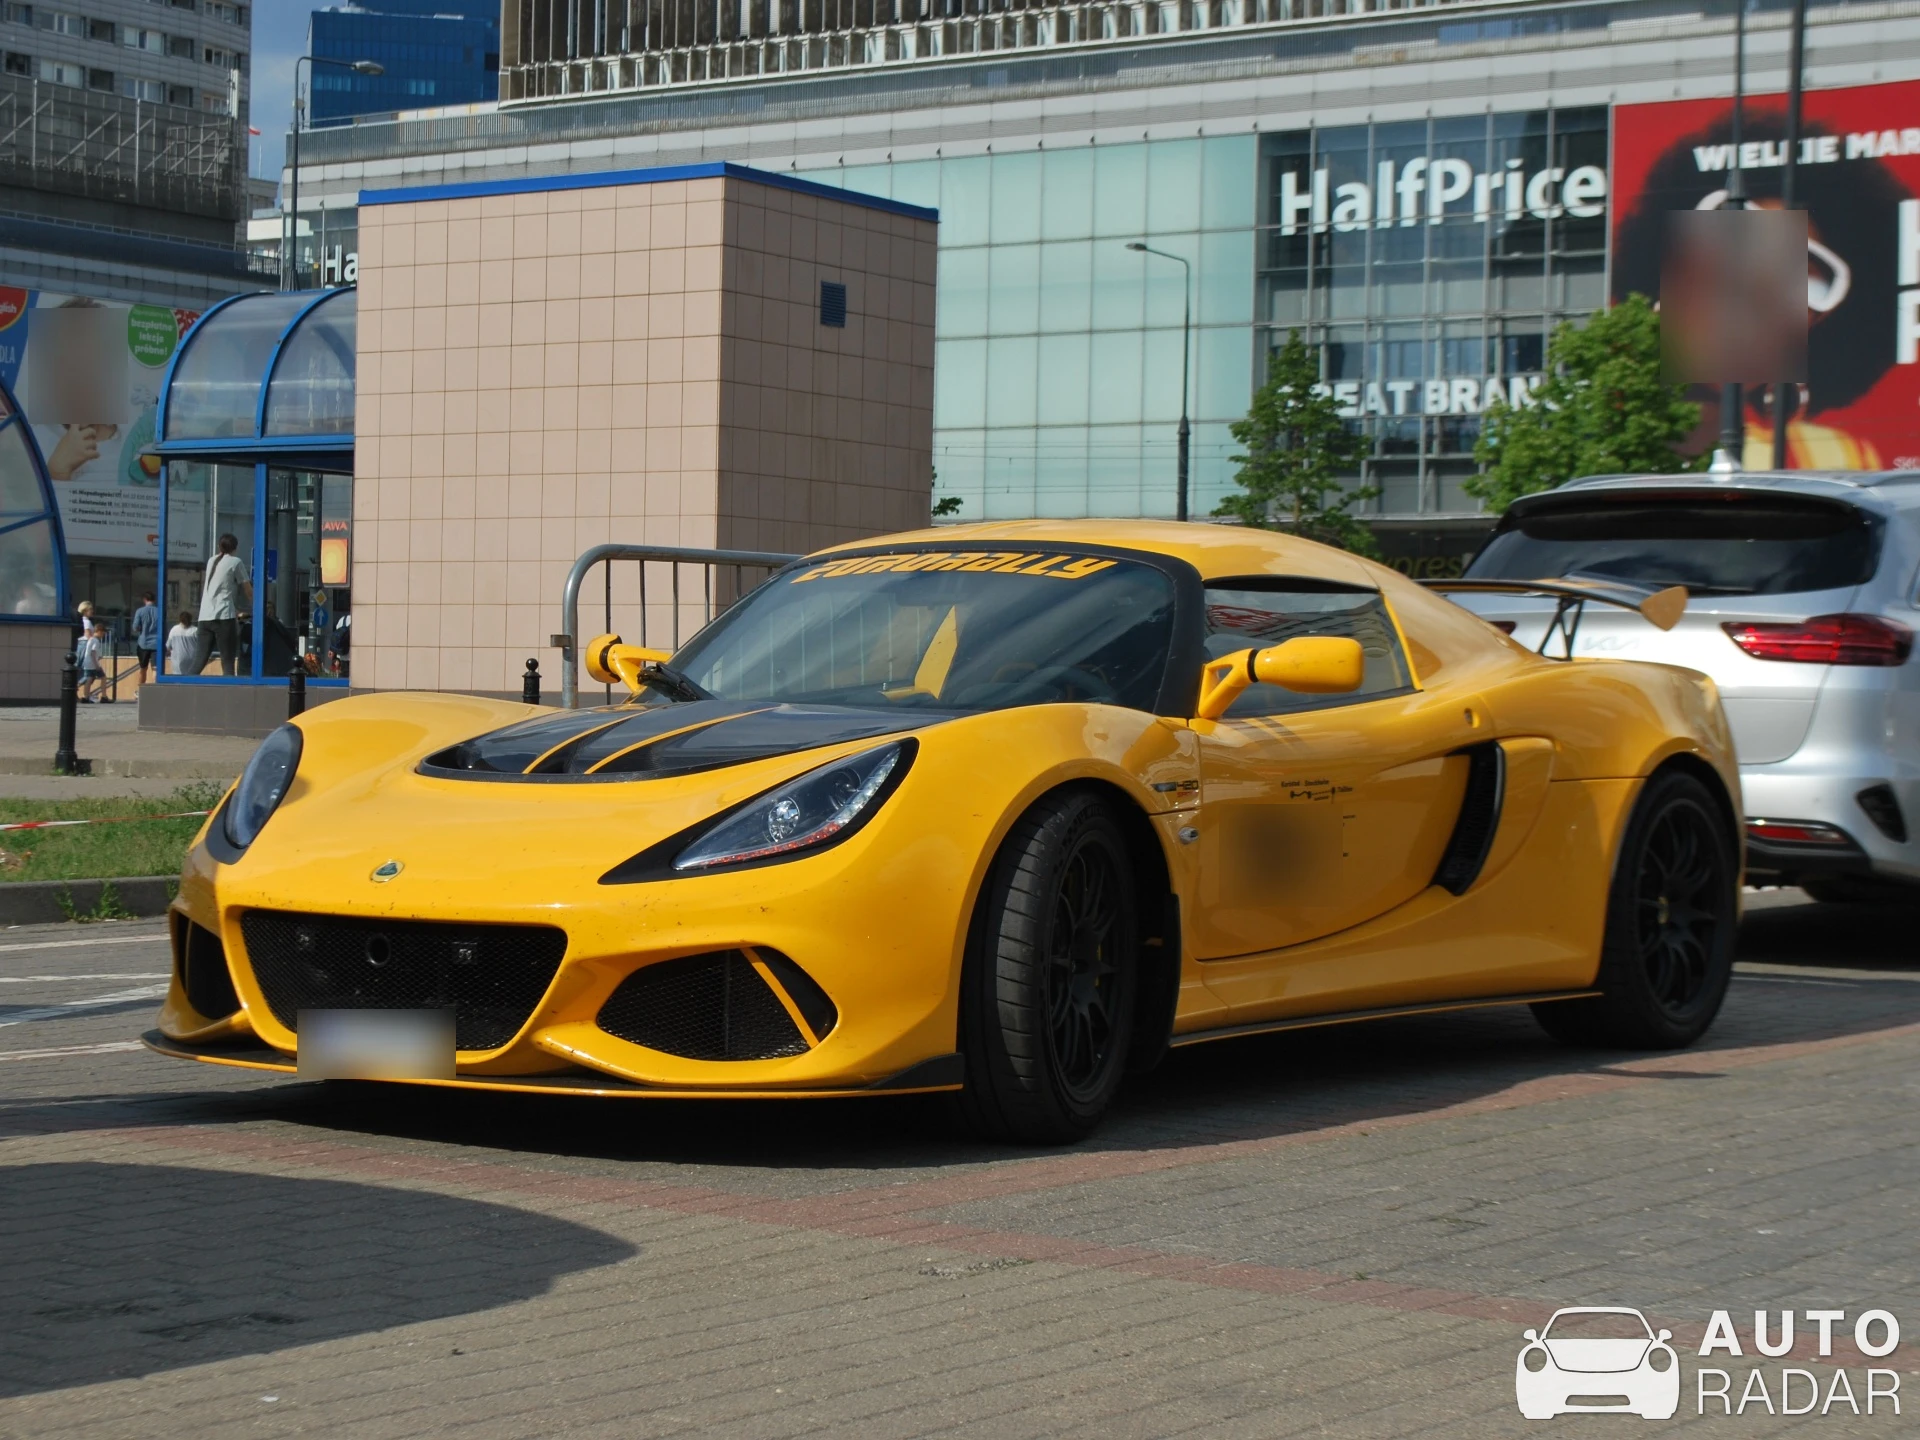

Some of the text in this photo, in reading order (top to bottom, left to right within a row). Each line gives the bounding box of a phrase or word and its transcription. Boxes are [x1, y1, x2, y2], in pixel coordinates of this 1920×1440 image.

[1281, 156, 1607, 236] HalfPrice
[789, 553, 1118, 583] EURORALLY
[1176, 780, 1199, 790] 420
